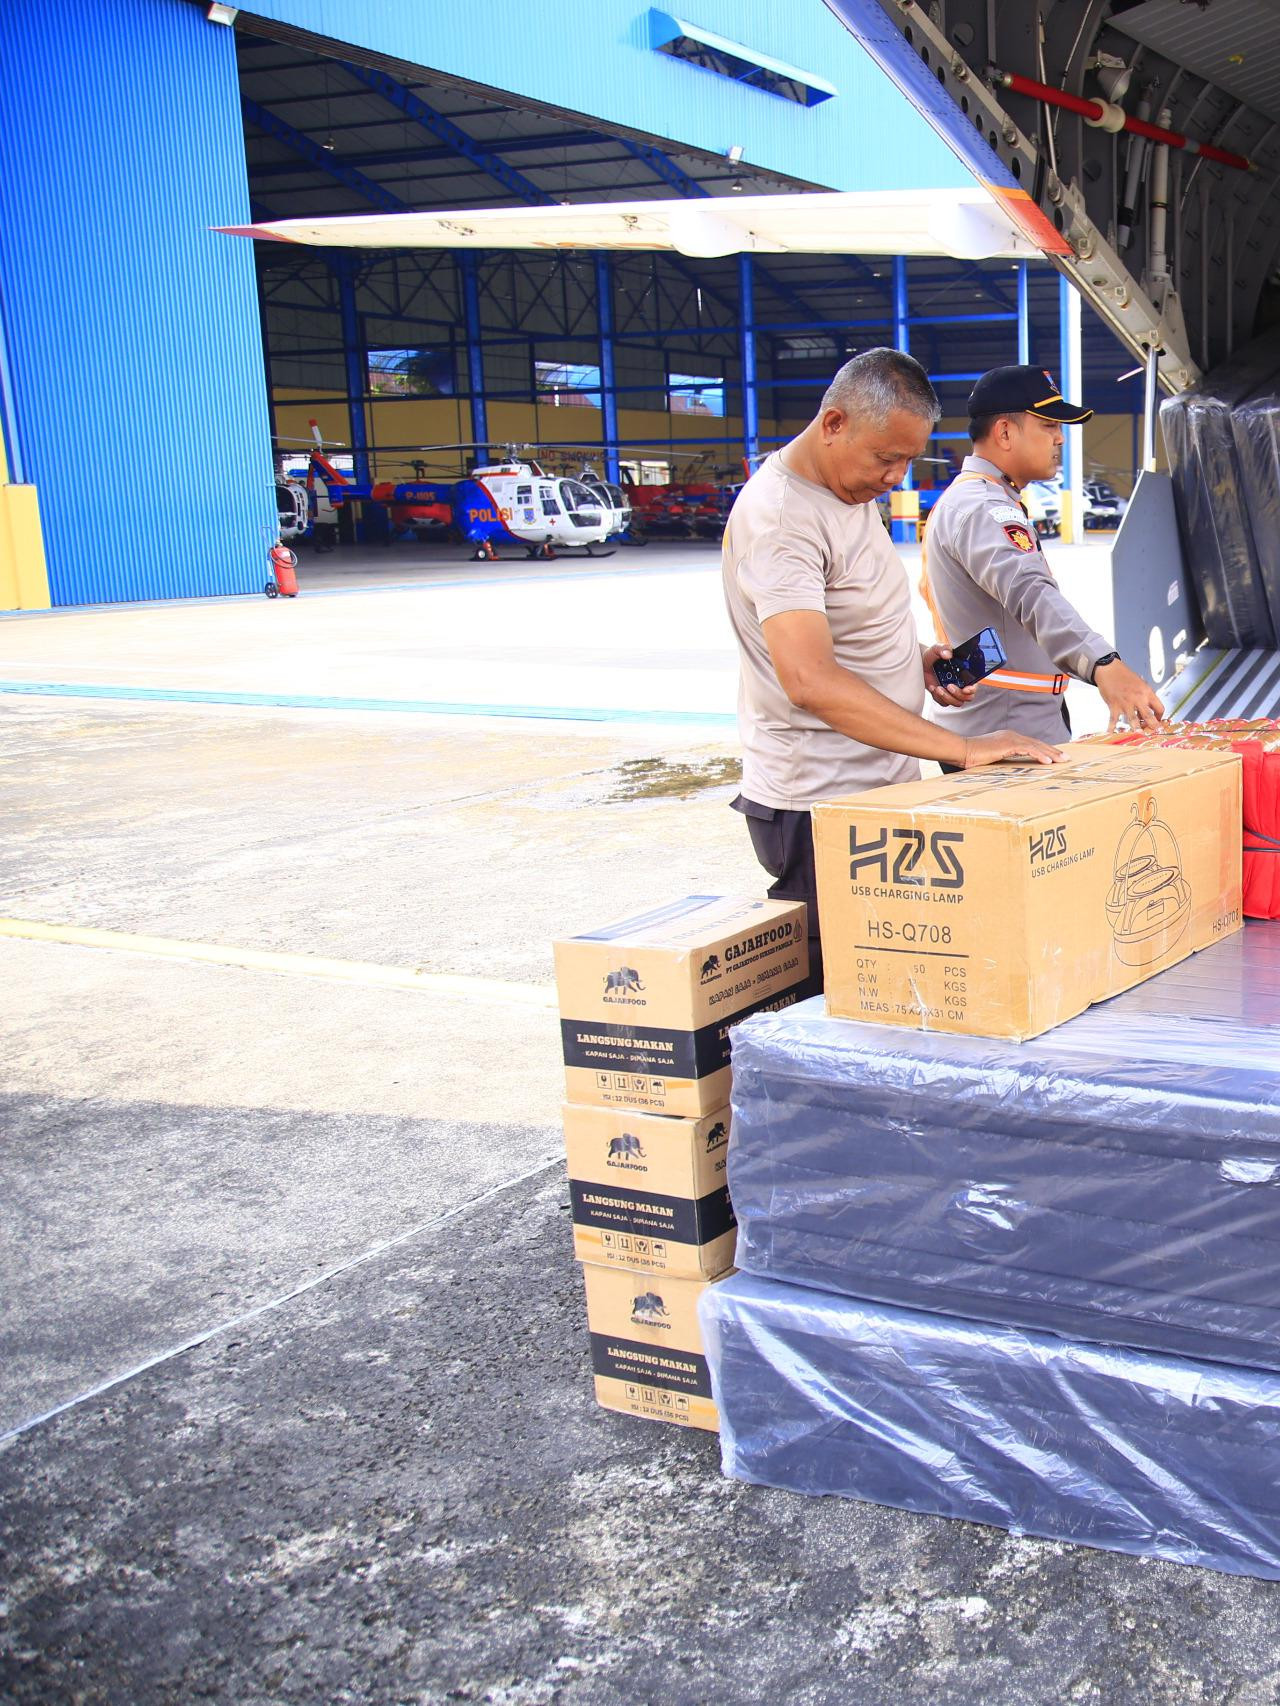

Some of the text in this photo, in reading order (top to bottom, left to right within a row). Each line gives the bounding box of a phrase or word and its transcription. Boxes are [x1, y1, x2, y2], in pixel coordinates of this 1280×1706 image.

[469, 507, 513, 523] POLISI
[1031, 866, 1045, 878] USB
[1046, 853, 1079, 873] CHARGING
[851, 885, 964, 904] USB CHARGING LAMP
[724, 923, 793, 961] GAJAHFOOD
[867, 920, 952, 943] HS-Q708
[856, 958, 877, 969] QTY
[944, 966, 967, 978] PCS
[857, 972, 877, 984] G.W
[944, 981, 967, 993] KGS
[858, 986, 879, 998] N.W
[944, 995, 967, 1007] KGS
[860, 1000, 890, 1012] MEAS
[947, 1010, 964, 1021] CM
[577, 1033, 674, 1052] LANGSUNG MAKAN
[585, 1050, 608, 1058] KAPAN
[630, 1055, 656, 1063] DIMANA
[657, 1057, 675, 1065] SAJA
[623, 1096, 638, 1104] DUS
[649, 1099, 665, 1107] PCS)
[582, 1193, 674, 1217] LANGSUNG MAKAN
[590, 1210, 612, 1219] KAPAN
[612, 1213, 628, 1222] SAJA
[633, 1217, 658, 1227] DIMANA
[658, 1222, 675, 1230] SAJA
[607, 1347, 697, 1374] LANGSUNG MAKAN
[614, 1363, 636, 1372] KAPAN
[636, 1367, 652, 1376] SAJA
[656, 1371, 681, 1382] DIMANA
[682, 1377, 698, 1386] SAJA
